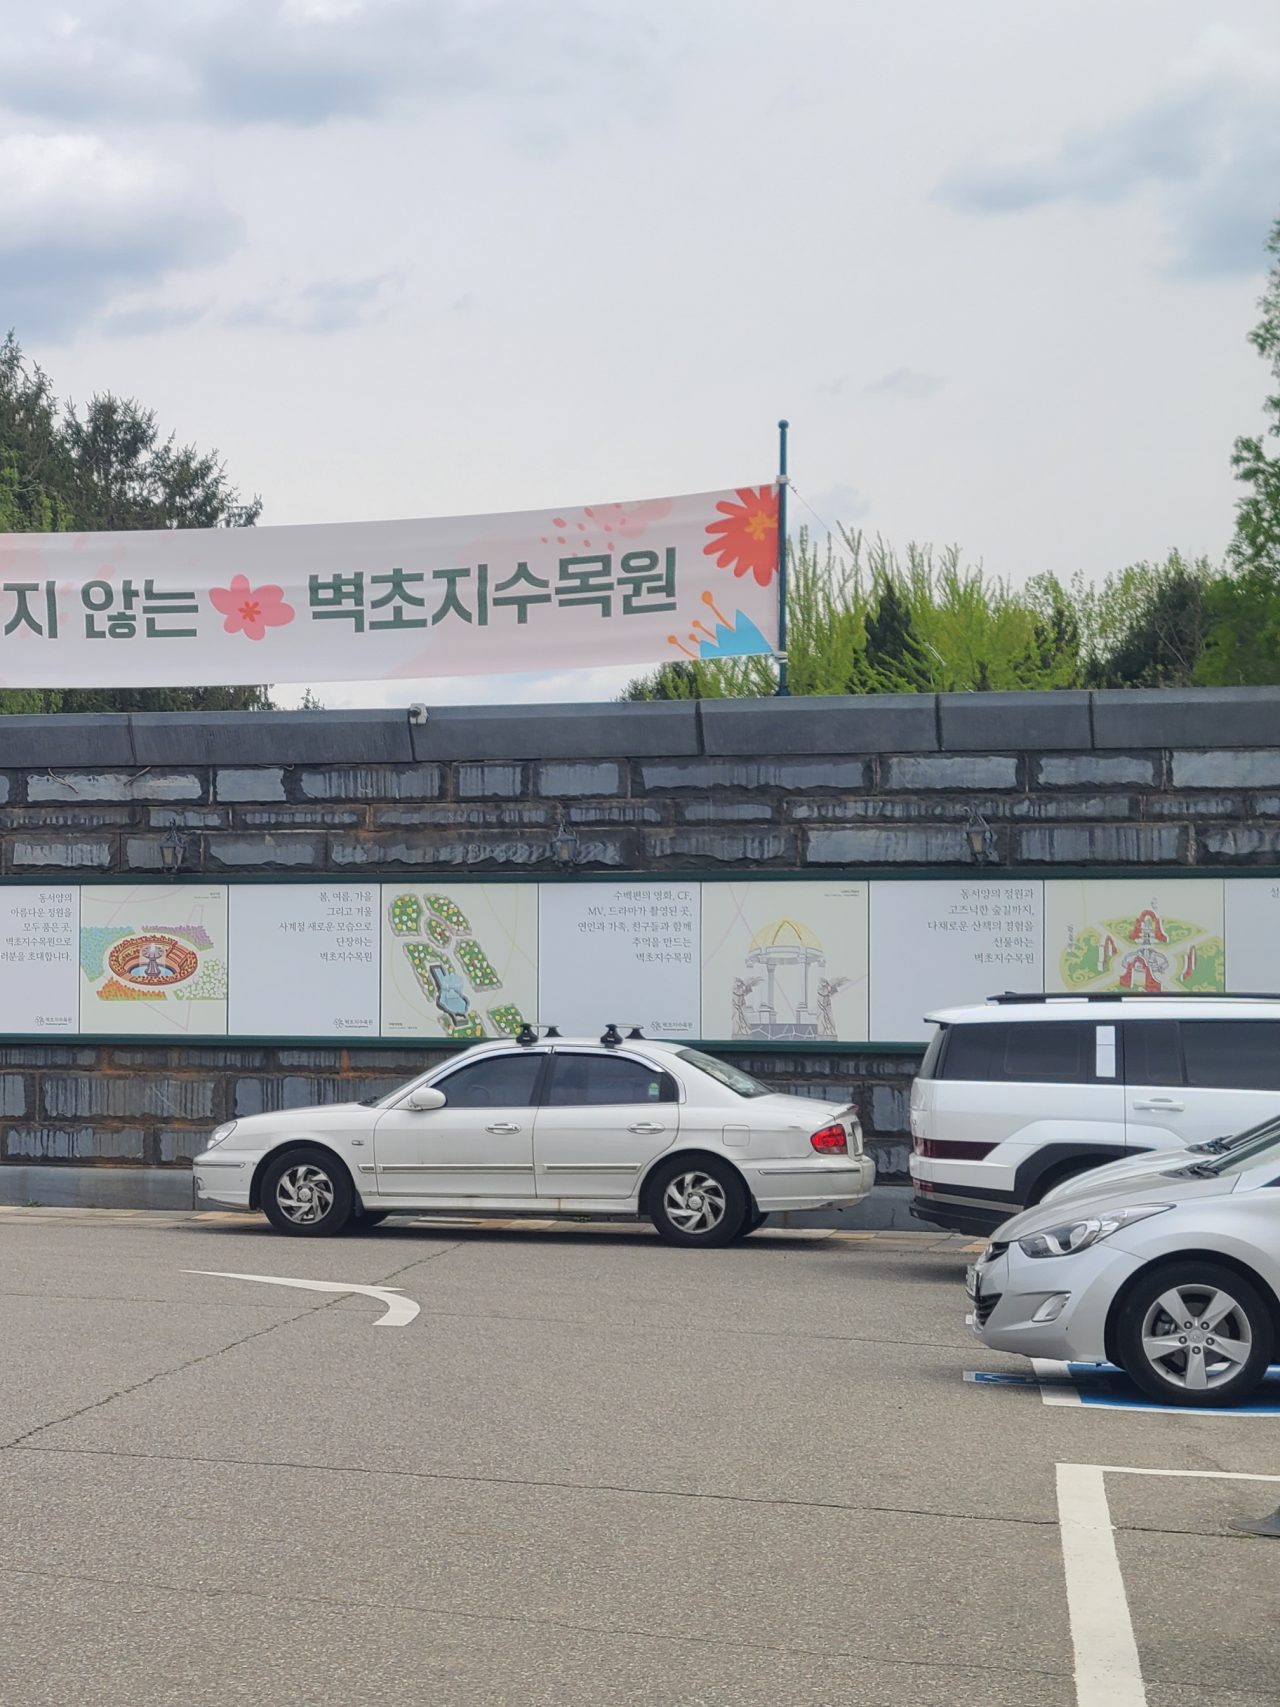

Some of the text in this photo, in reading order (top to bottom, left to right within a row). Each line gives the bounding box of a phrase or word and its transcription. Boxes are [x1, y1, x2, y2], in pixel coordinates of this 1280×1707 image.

[80, 578, 200, 638] 않는
[308, 546, 677, 633] 벽초지수목원
[39, 893, 72, 903] 동서양의
[355, 891, 372, 902] 가을
[961, 888, 1033, 900] 동서양의 정원과
[10, 908, 72, 918] 아름다운 정원을
[327, 907, 353, 917] 그리고
[608, 906, 646, 917] 드라마가
[948, 905, 988, 916] 고즈넉한
[23, 922, 41, 932] 모두
[42, 922, 60, 932] 품은
[280, 922, 373, 932] 사계절 새로운 모습으로
[578, 921, 605, 932] 연인과
[632, 921, 670, 932] 친구들과
[673, 921, 692, 932] 함께
[928, 920, 1034, 932] 다채로운 산책의 경험을
[6, 937, 72, 947] 벽초지수목원으로
[336, 937, 373, 947] 단장하는
[632, 937, 692, 948] 추억을 만드는
[993, 937, 1034, 948] 선물하는
[320, 952, 373, 962] 벽초지수목원
[636, 952, 692, 963] 벽초지수목원
[974, 953, 1034, 964] 벽초지수목원
